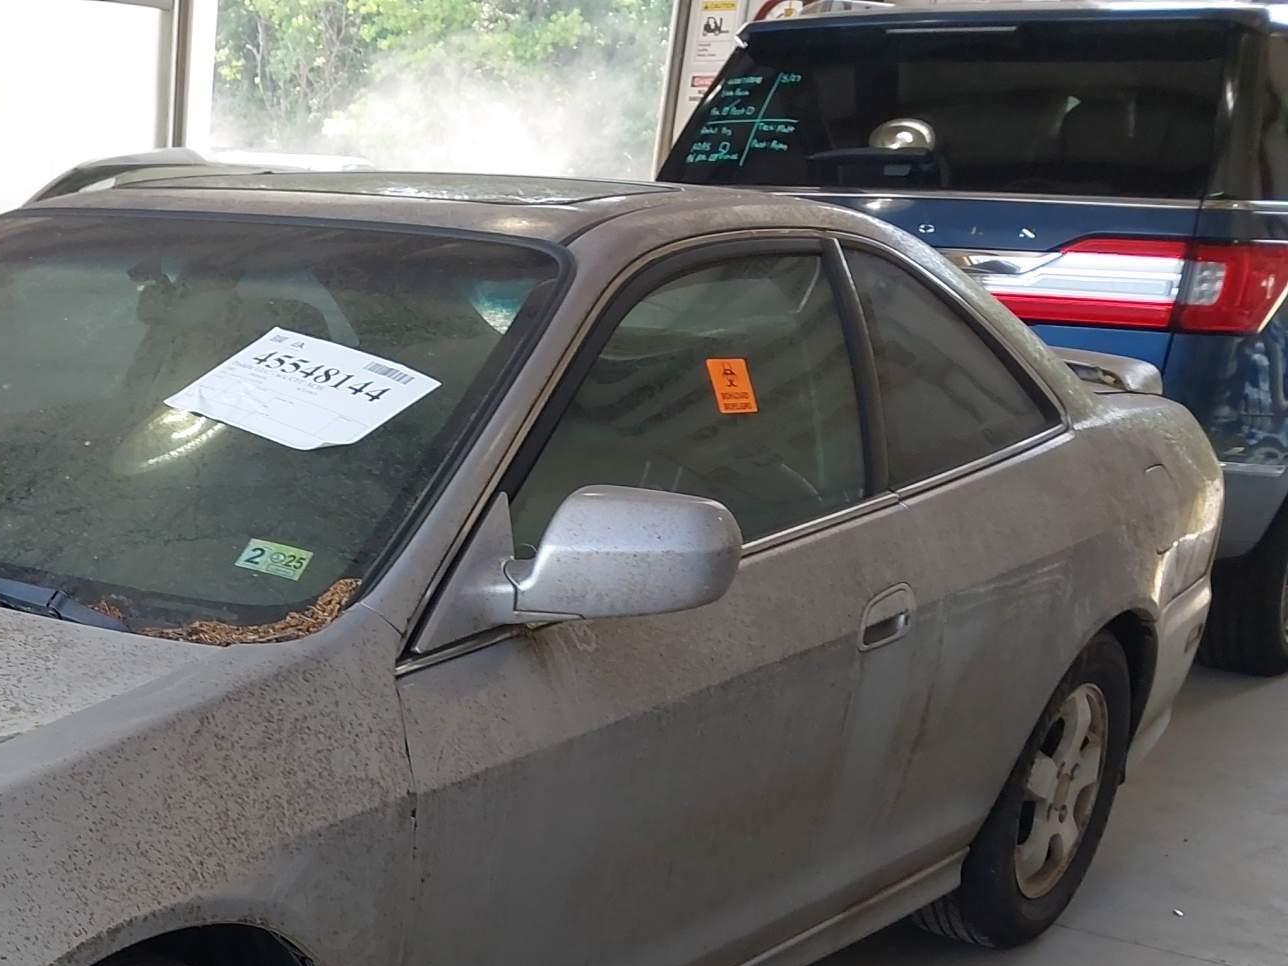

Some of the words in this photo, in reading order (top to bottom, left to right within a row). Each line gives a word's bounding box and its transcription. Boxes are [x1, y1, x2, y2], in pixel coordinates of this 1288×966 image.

[252, 351, 391, 402] 45548144
[244, 547, 265, 565] 2
[283, 554, 306, 570] 25
